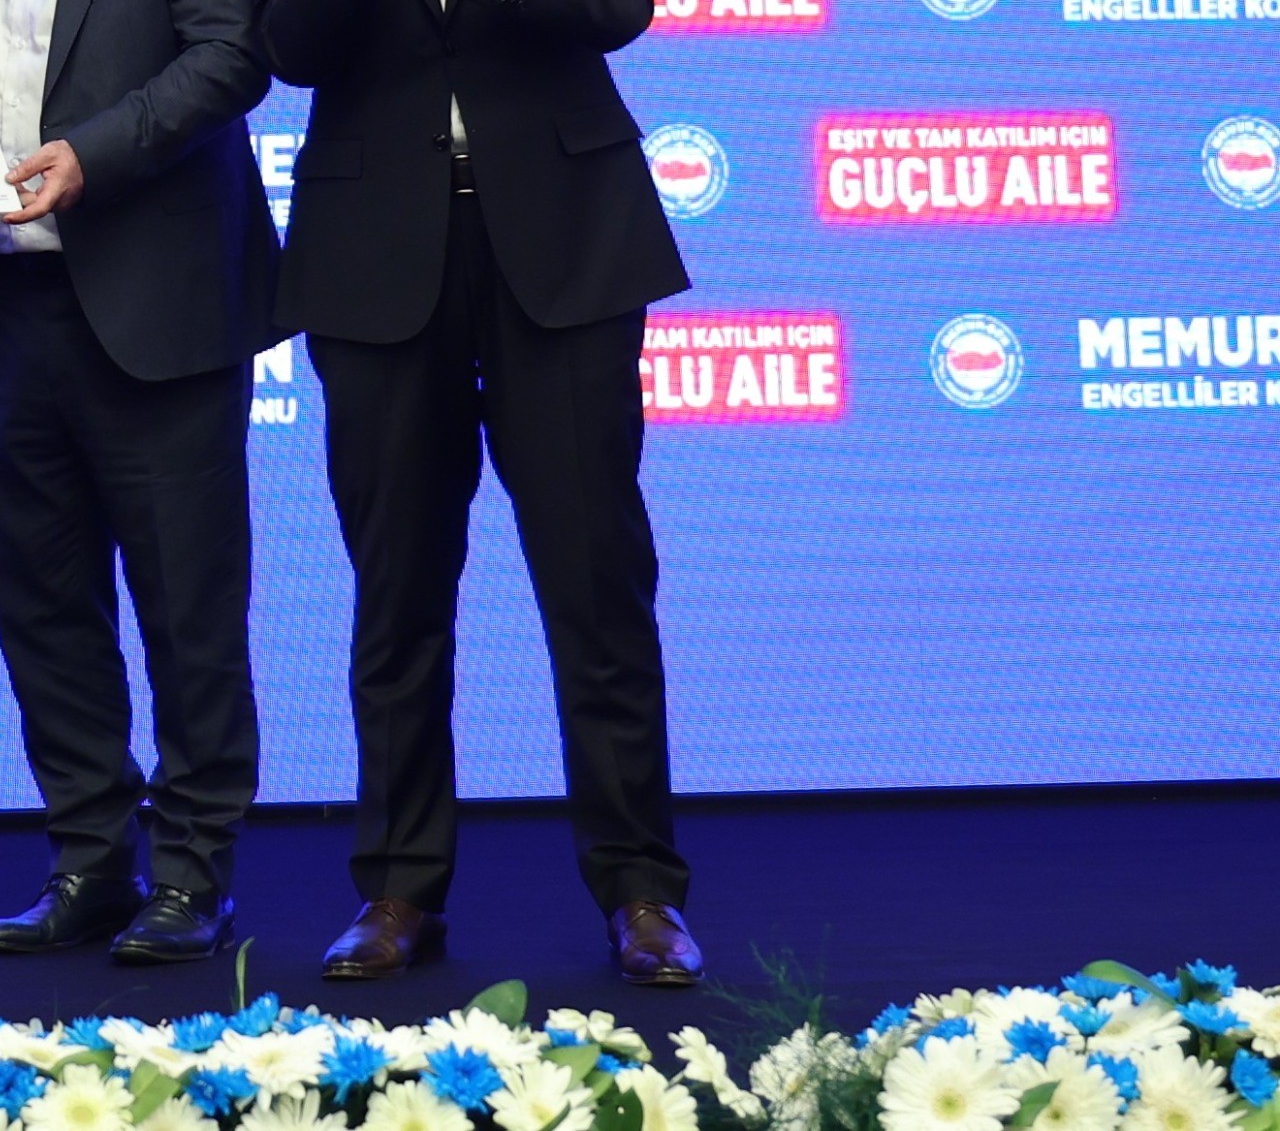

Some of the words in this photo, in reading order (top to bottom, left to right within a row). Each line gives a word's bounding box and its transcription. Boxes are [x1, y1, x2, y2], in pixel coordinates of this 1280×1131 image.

[882, 128, 911, 149] VE
[915, 128, 962, 148] TAM
[967, 127, 1057, 147] KATILIM
[692, 326, 783, 348] KATILIM
[1079, 315, 1280, 368] MEMUR
[1083, 376, 1257, 407] ENGELLİLER
